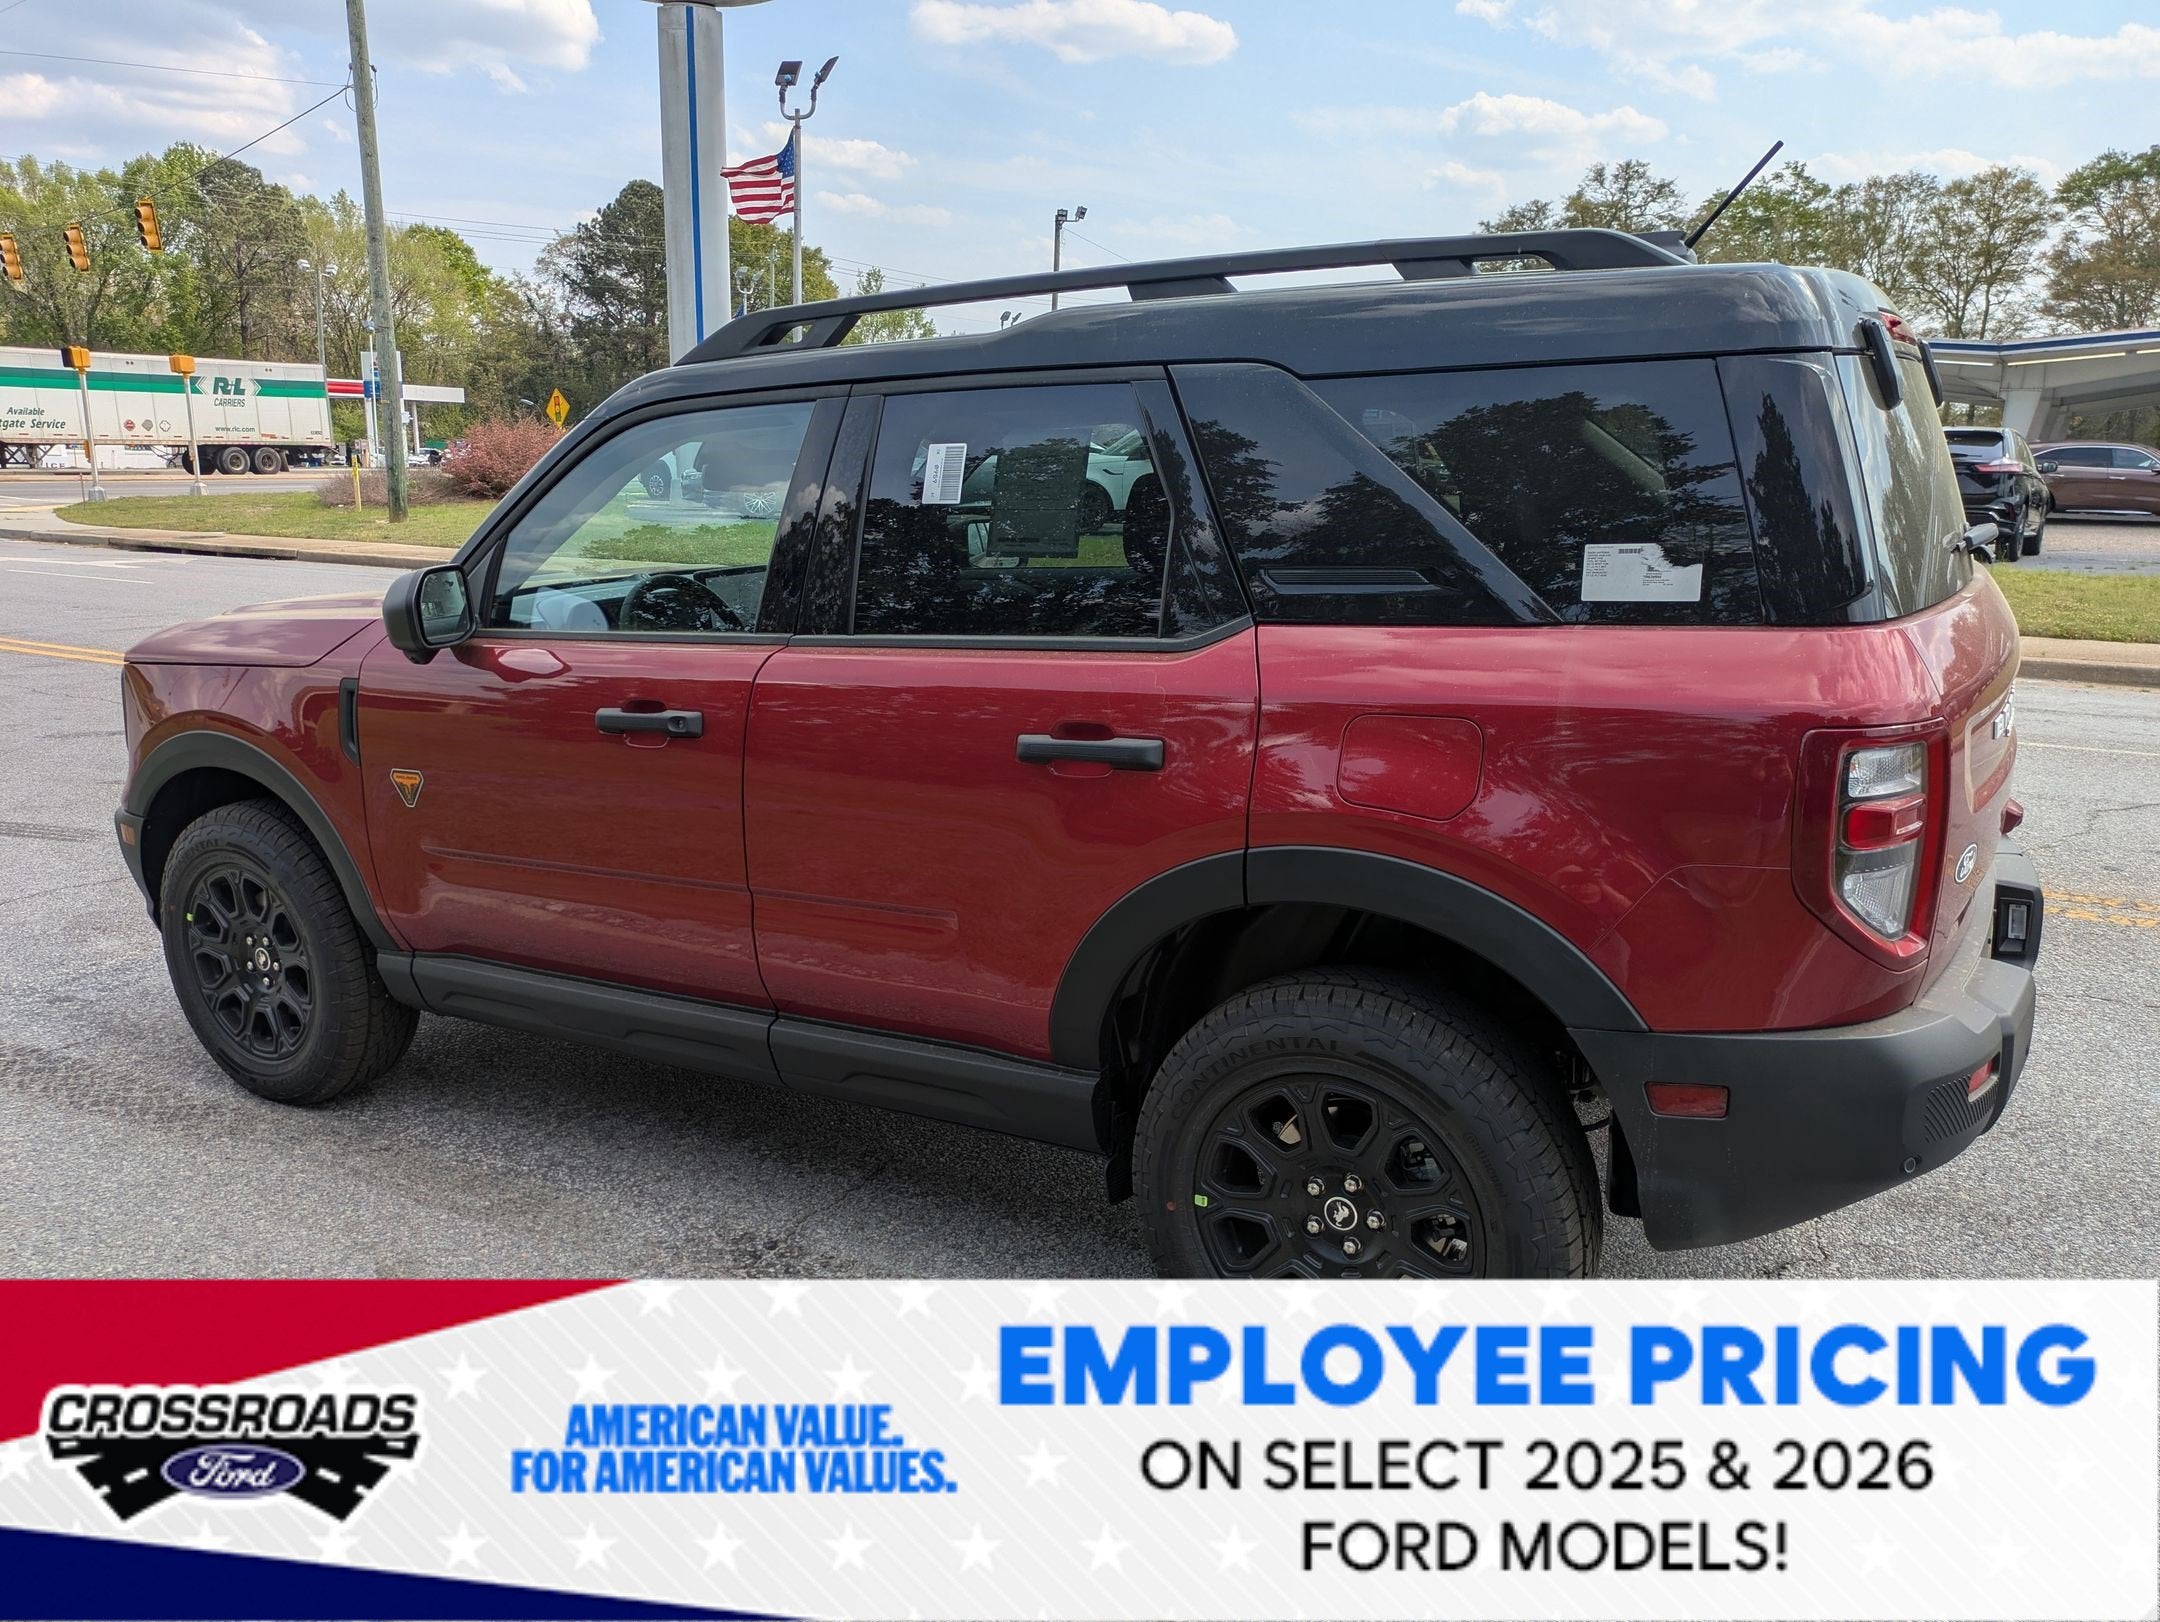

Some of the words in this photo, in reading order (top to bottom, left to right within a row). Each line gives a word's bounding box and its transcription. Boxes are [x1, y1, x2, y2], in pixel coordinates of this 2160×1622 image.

[213, 397, 246, 408] CARRIERS
[6, 406, 45, 416] Available
[30, 418, 66, 429] Service
[1172, 1037, 1338, 1121] CONTINENTAL
